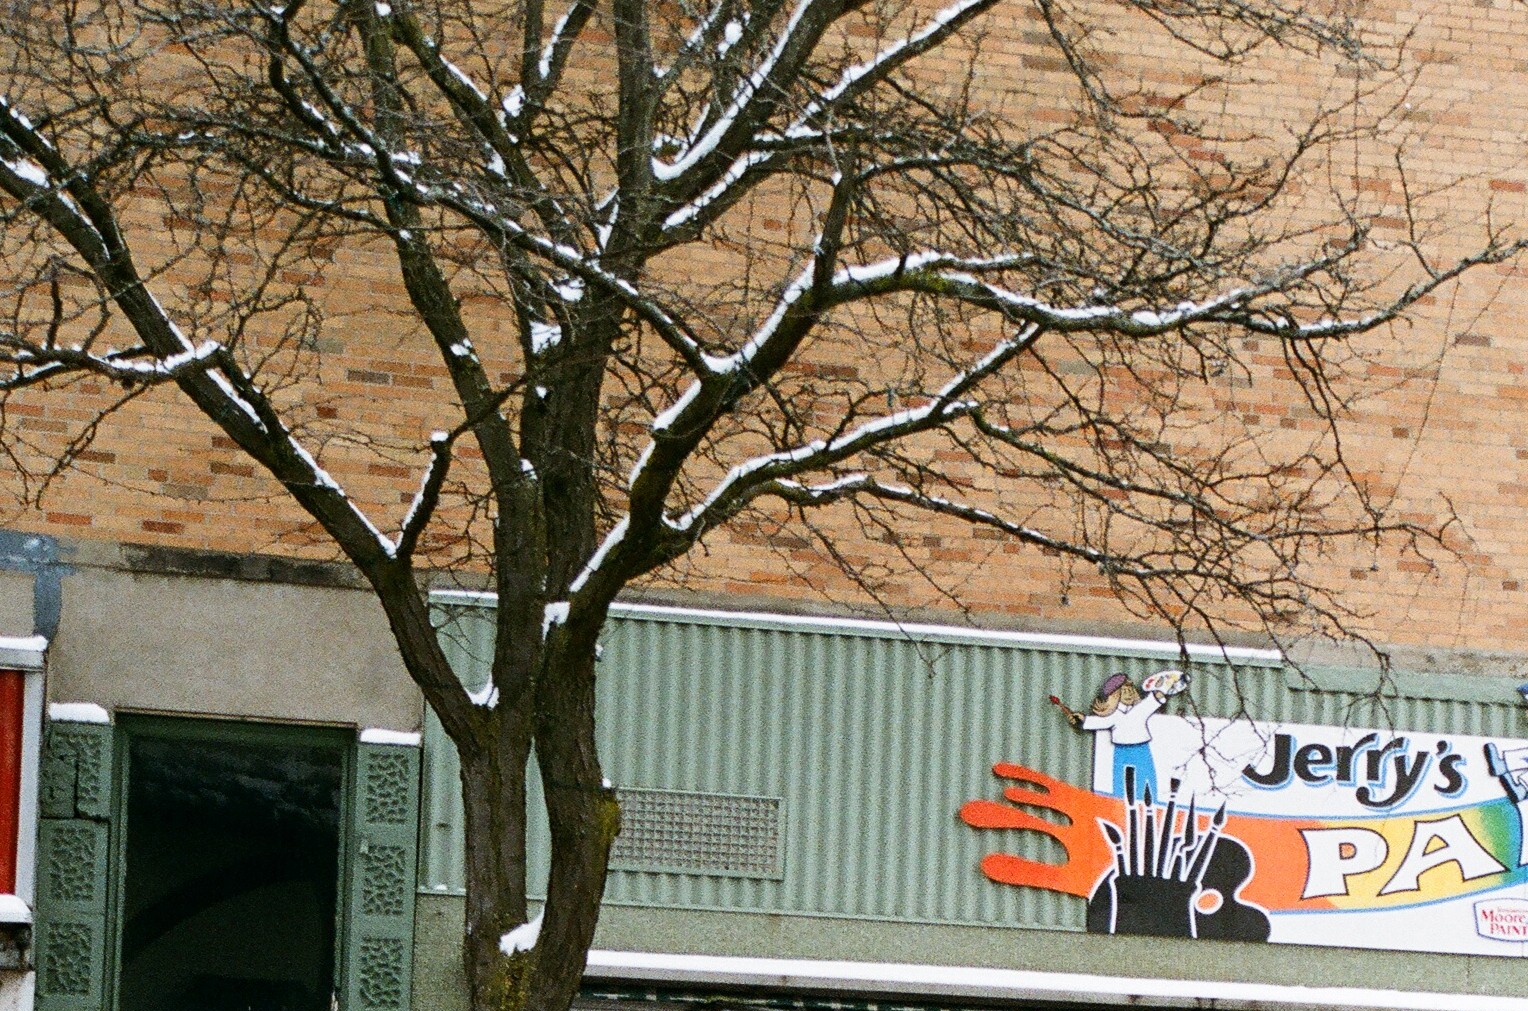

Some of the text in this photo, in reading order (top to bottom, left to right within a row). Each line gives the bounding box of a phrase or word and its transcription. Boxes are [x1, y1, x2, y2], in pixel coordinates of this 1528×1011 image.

[1242, 733, 1466, 810] Jerry's
[1481, 909, 1525, 923] Moore
[1490, 923, 1527, 935] PAINT
